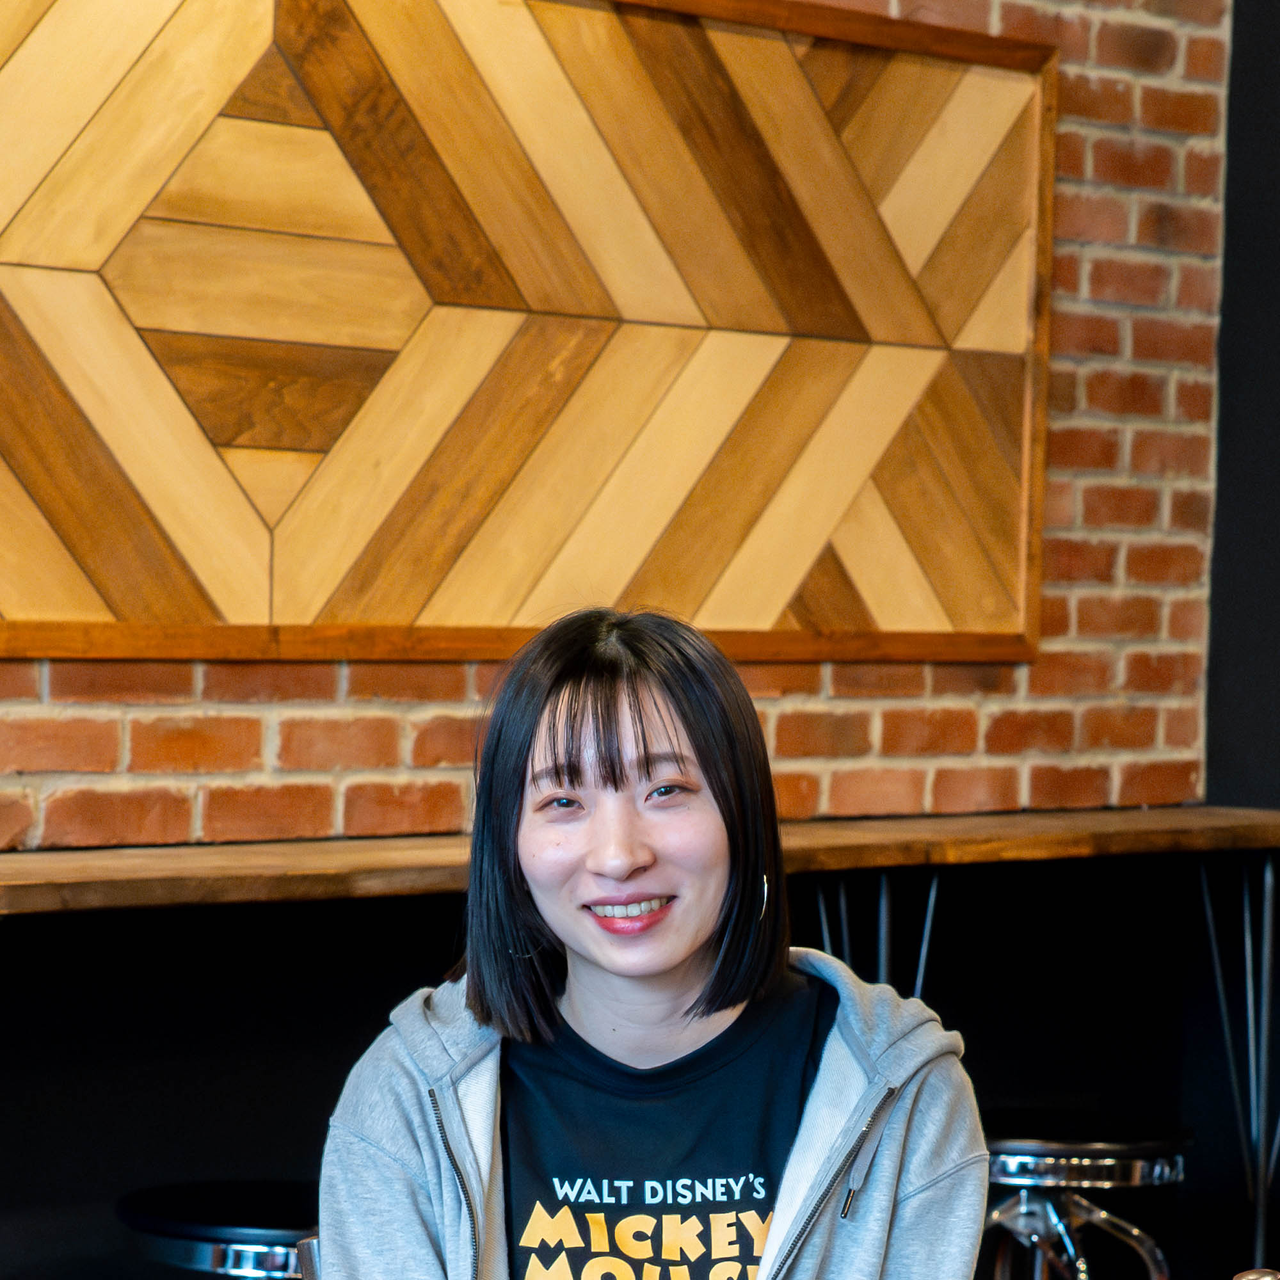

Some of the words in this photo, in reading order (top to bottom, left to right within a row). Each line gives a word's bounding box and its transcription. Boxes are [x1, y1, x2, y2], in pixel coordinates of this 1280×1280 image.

[552, 1177, 634, 1204] WALT
[644, 1173, 766, 1205] DISNEY'S
[518, 1200, 774, 1262] MICKEY
